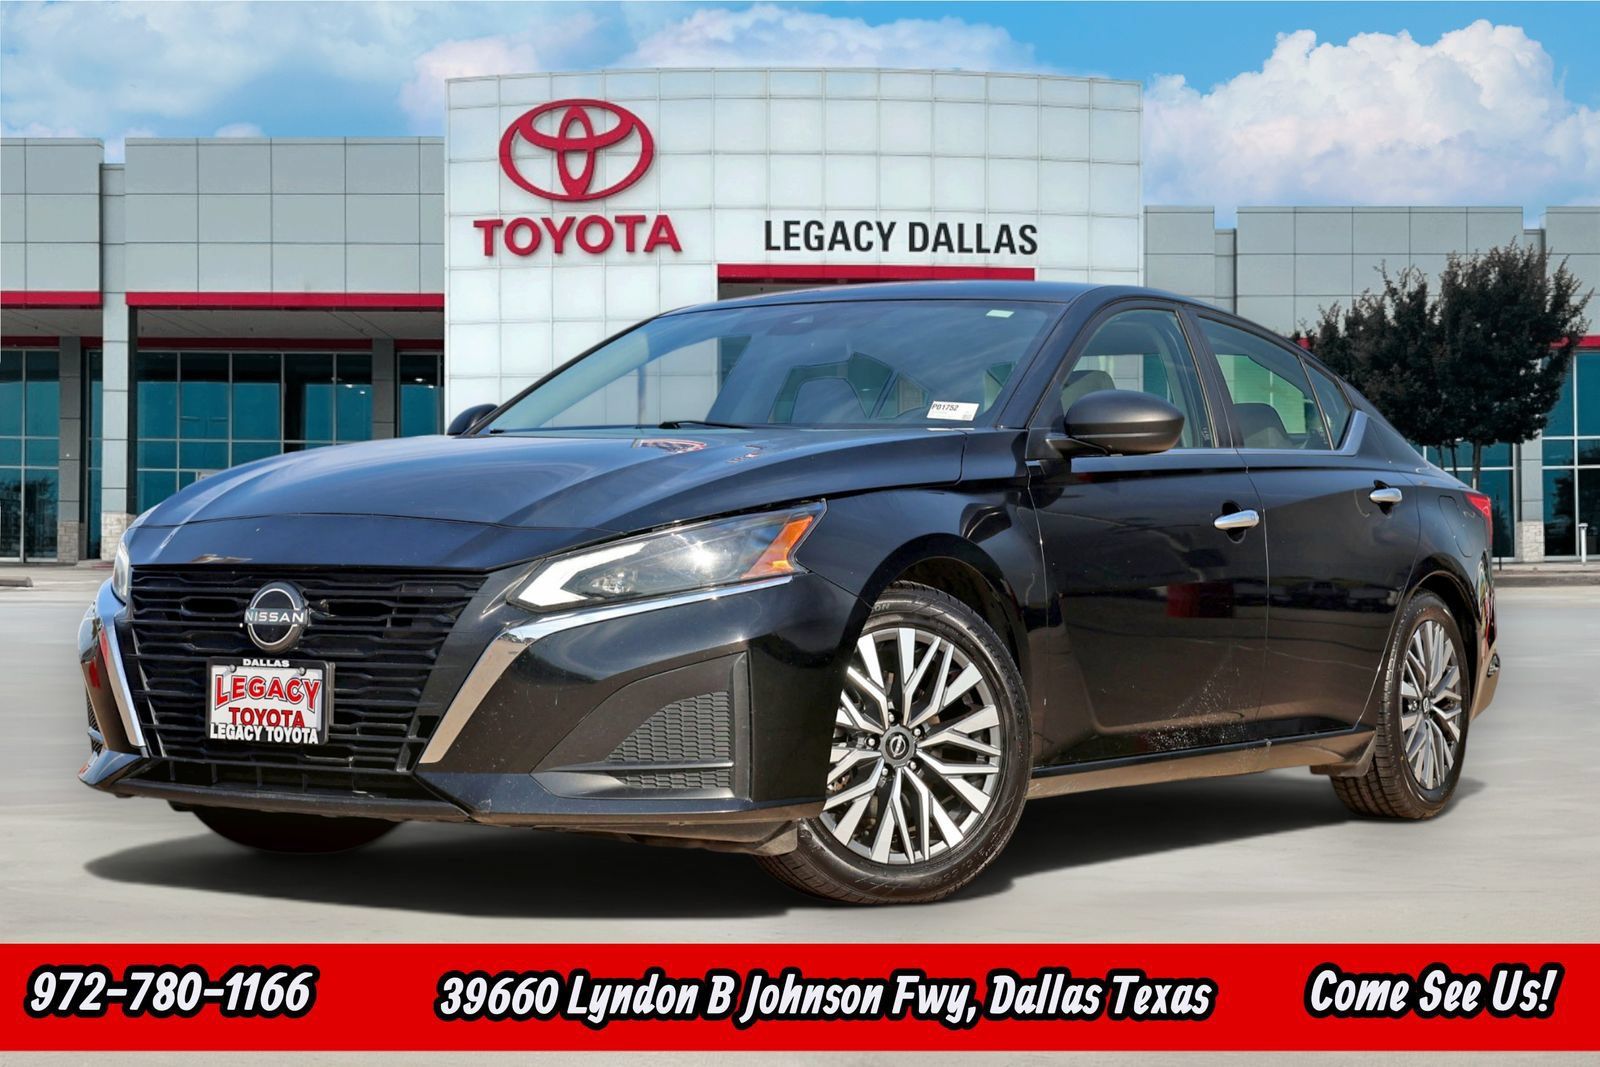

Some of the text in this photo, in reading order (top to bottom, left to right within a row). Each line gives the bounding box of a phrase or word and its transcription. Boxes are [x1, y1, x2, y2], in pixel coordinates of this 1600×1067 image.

[474, 214, 682, 256] TOYOTA
[765, 220, 1038, 255] LEGACY DALLAS
[244, 611, 304, 623] NISSAN
[242, 658, 290, 668] DALLAS
[215, 674, 321, 713] LEGACY
[228, 706, 306, 728] TOYOTA
[210, 722, 319, 745] LEGACY TOYOTA
